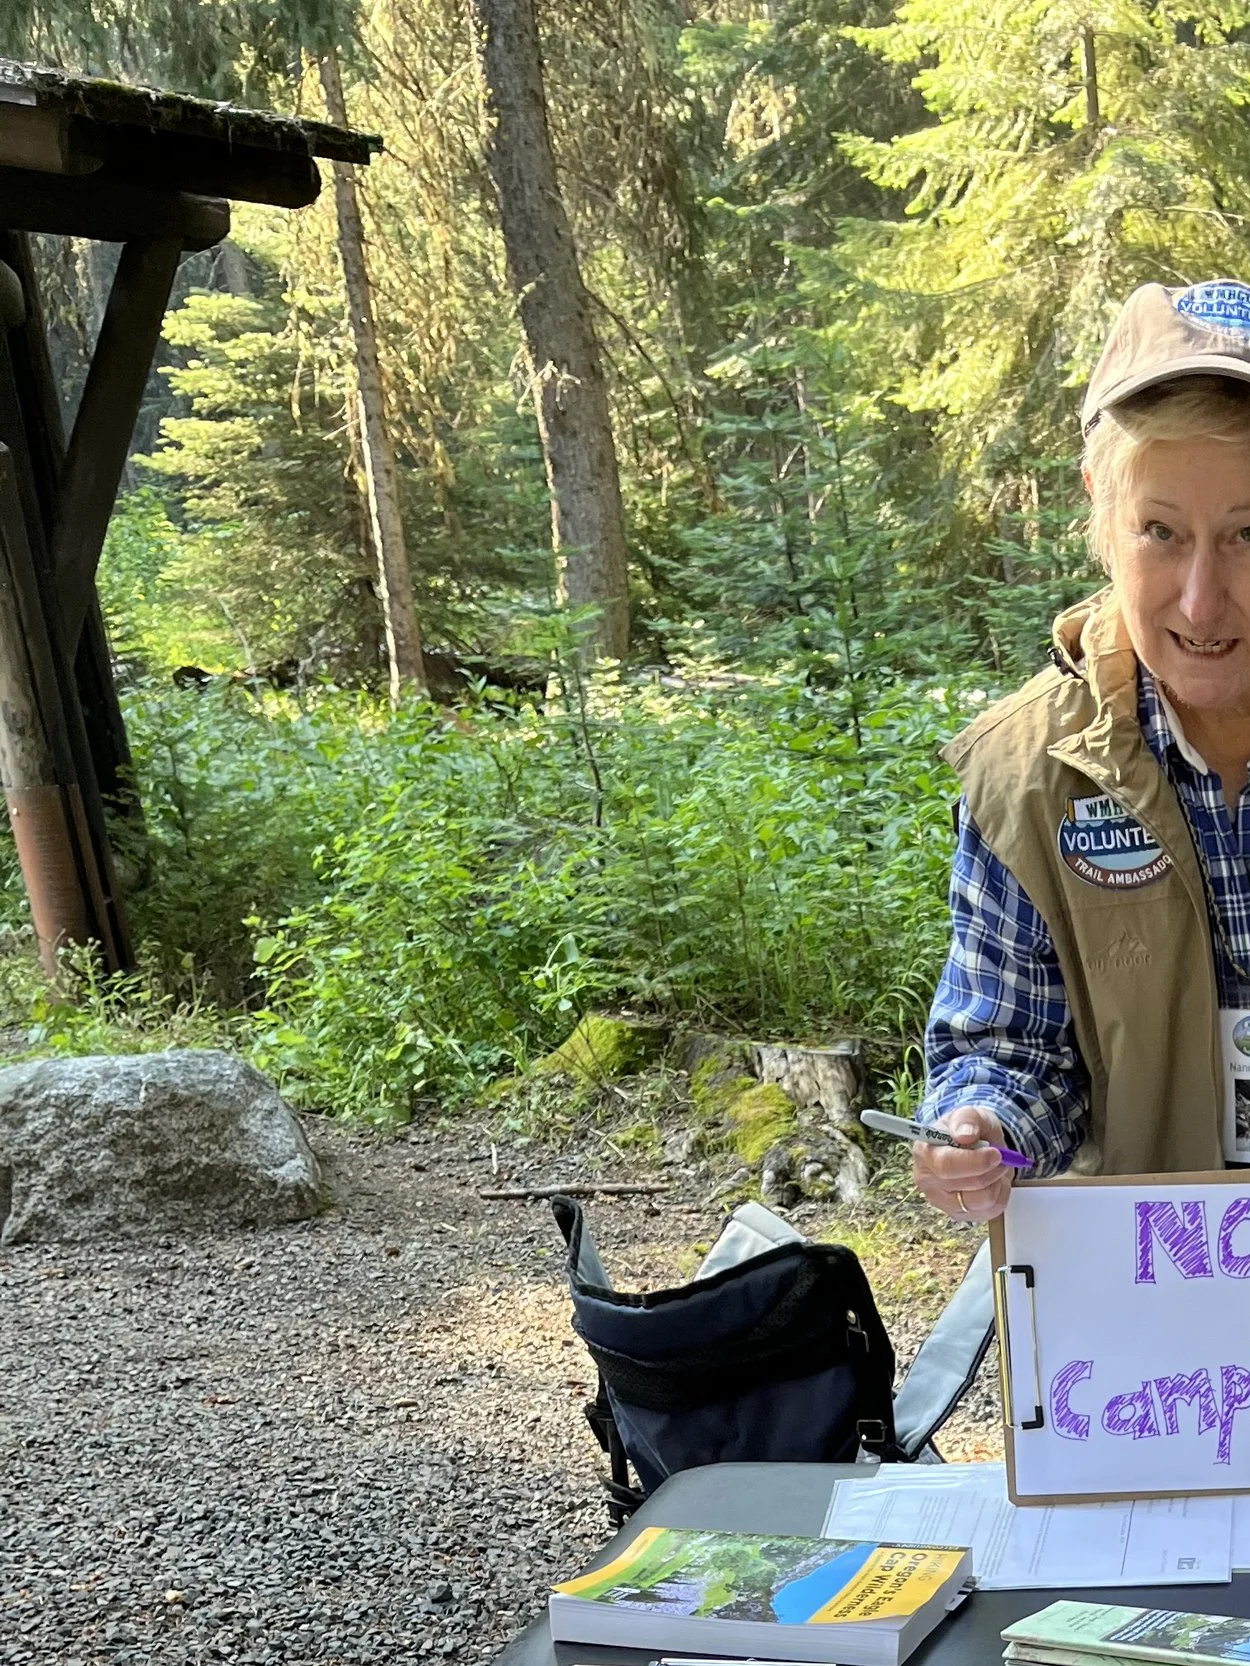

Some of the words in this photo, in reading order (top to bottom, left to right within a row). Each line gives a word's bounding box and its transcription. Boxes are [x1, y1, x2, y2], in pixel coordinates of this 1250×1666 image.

[1086, 798, 1124, 818] WMH
[1063, 826, 1156, 851] VOLUNTE
[1075, 857, 1103, 882] TRAIL
[1107, 854, 1172, 885] AMBASSADO
[880, 1552, 906, 1572] Cap
[884, 1552, 928, 1598] Oregon's
[919, 1553, 945, 1582] HIKING
[834, 1573, 893, 1618] Wilderness
[859, 1596, 893, 1617] Eagle
